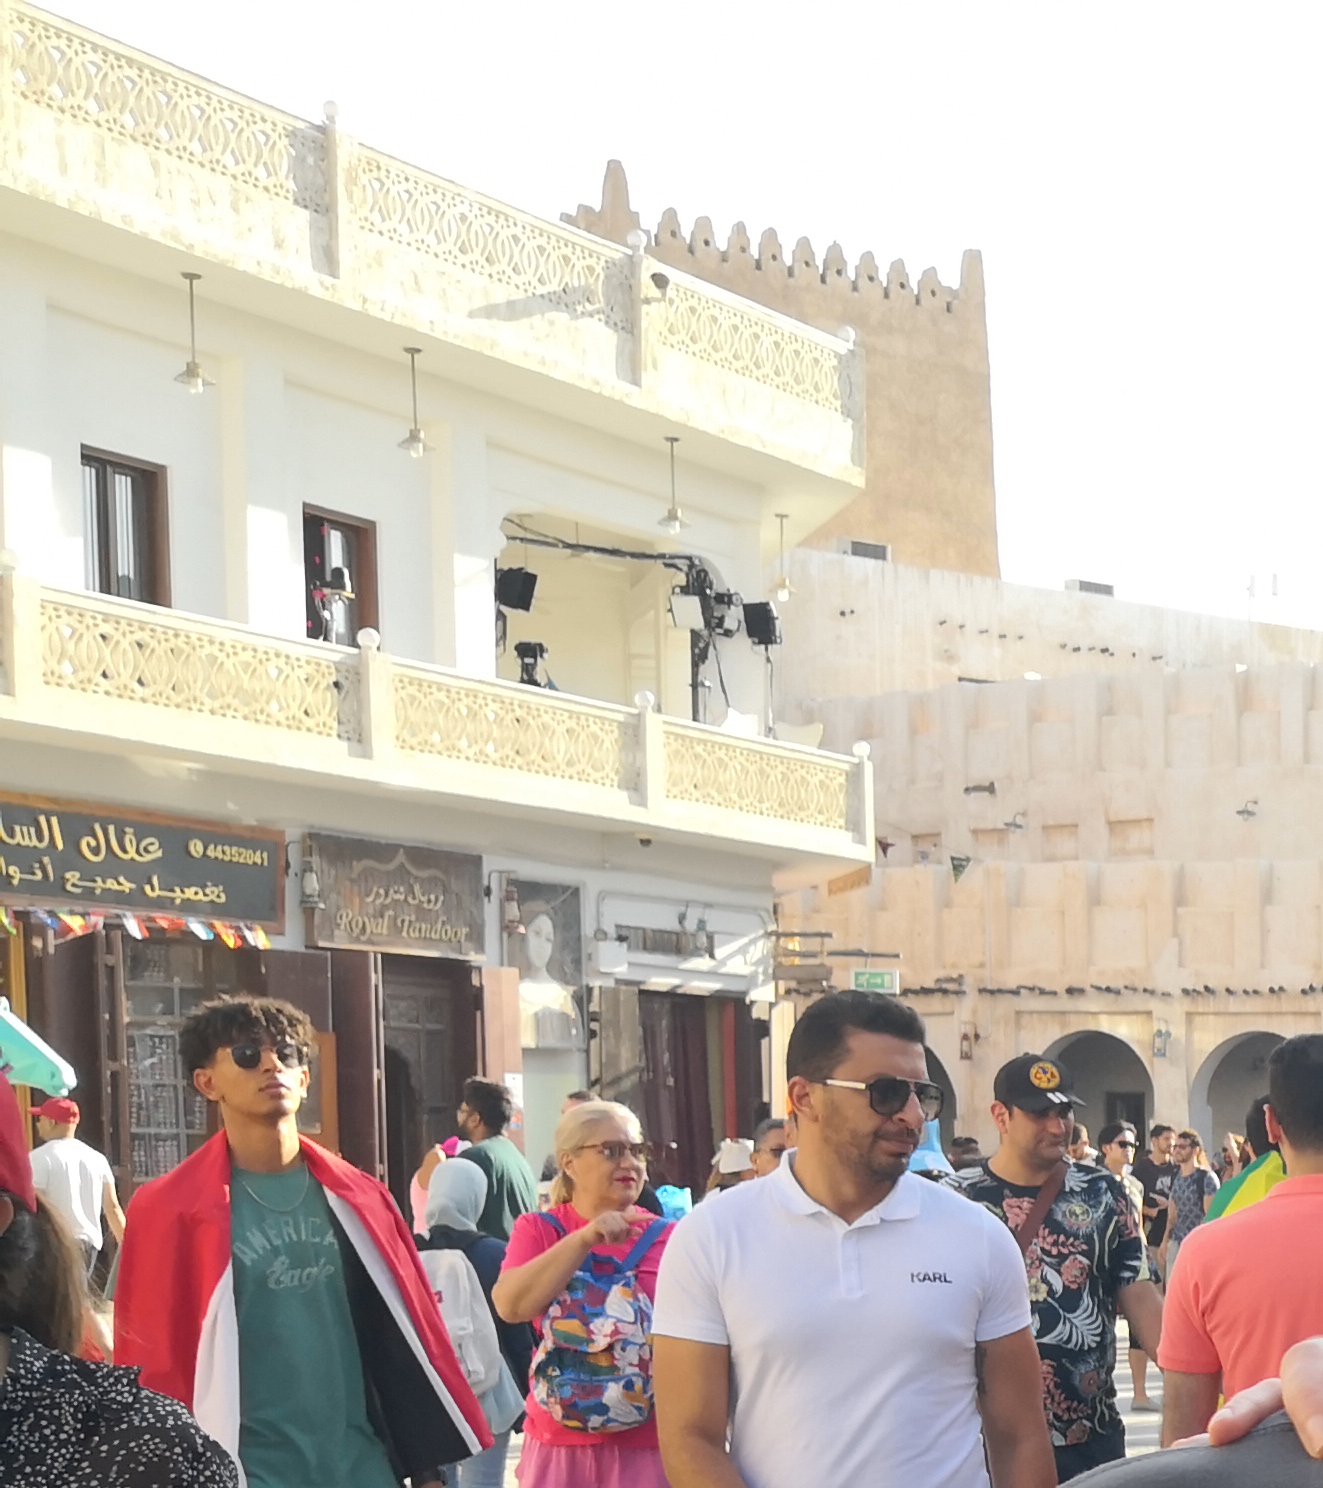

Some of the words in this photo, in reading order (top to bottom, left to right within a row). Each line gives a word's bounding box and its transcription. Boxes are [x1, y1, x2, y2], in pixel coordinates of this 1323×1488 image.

[79, 823, 162, 862] عقال
[206, 843, 268, 867] 44352041
[336, 908, 394, 940] Royal
[397, 915, 470, 943] Tandoor
[910, 1271, 953, 1284] KARL
